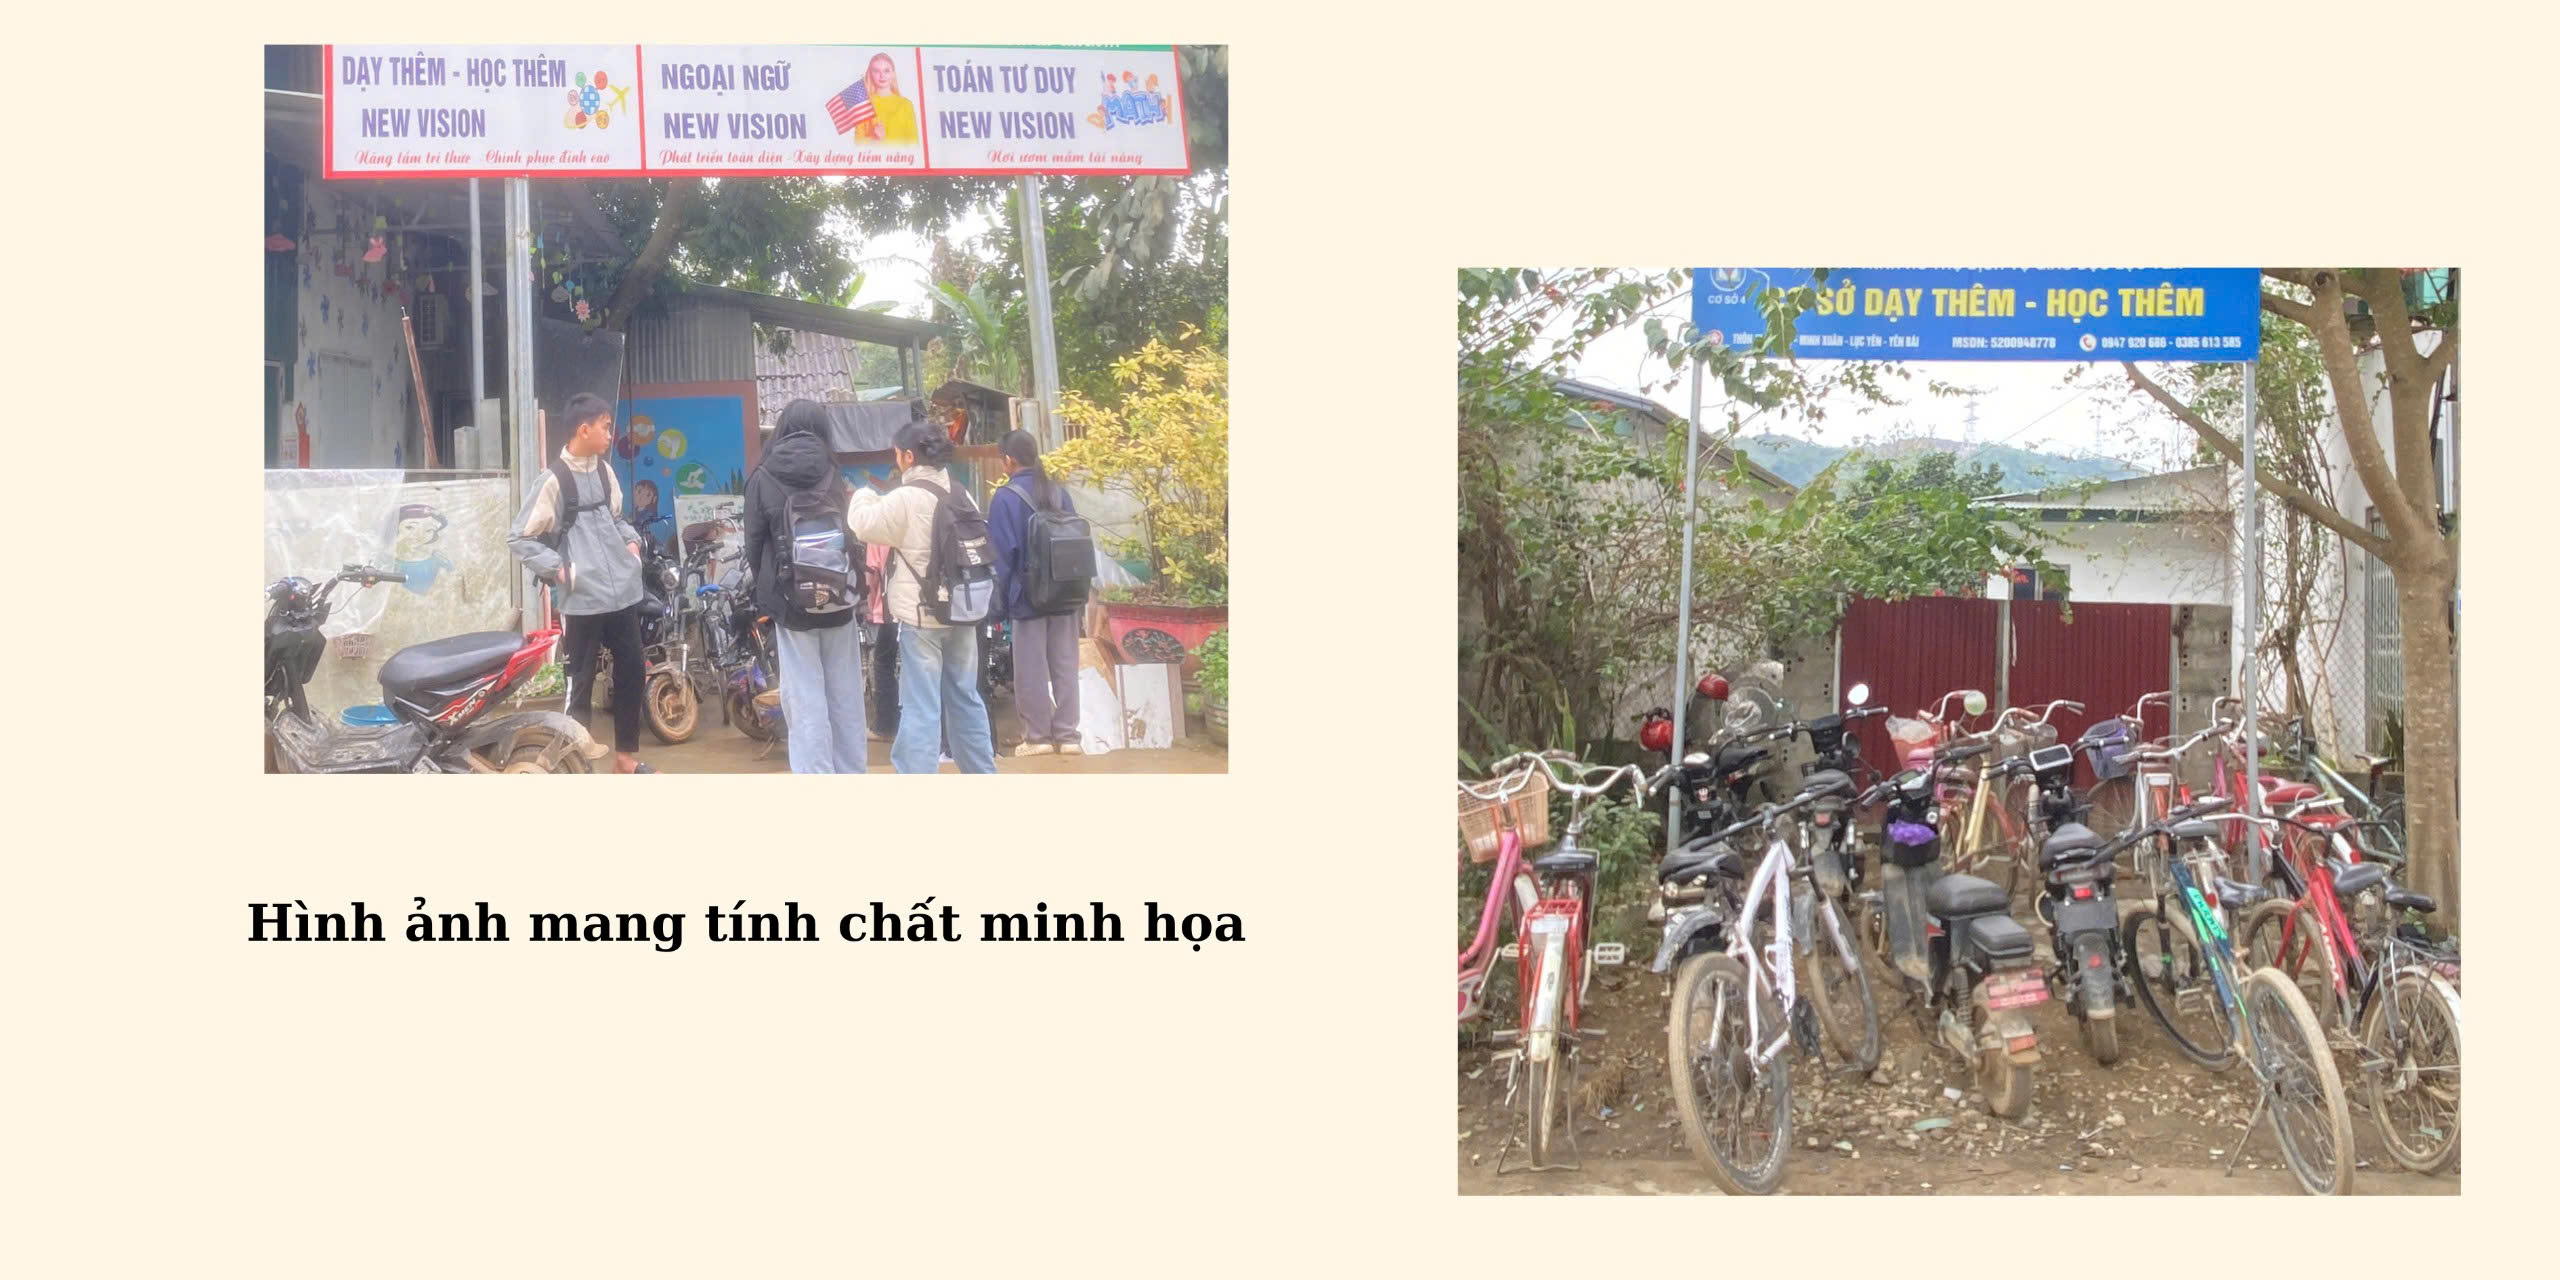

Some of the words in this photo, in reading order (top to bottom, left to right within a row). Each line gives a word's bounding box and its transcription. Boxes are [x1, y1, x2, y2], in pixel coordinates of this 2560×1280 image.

[343, 56, 382, 92] DẠY
[389, 51, 445, 86] THÊM
[467, 58, 506, 93] HỌC
[513, 54, 566, 87] THÊM
[661, 64, 735, 96] NGOẠI
[743, 60, 791, 90] NGỮ
[933, 60, 994, 93] TOÁN
[1000, 64, 1029, 93] TƯ
[1034, 67, 1075, 93] DUY
[362, 108, 411, 137] NEW
[417, 109, 485, 137] VISION
[939, 111, 991, 138] NEW
[1000, 112, 1075, 139] VISION
[1102, 90, 1165, 130] MATH
[664, 113, 719, 139] NEW
[727, 114, 806, 139] VISION
[1708, 294, 1723, 304] CƠ
[1740, 296, 1746, 304] 4
[1817, 278, 1856, 315] SỞ
[1865, 288, 1922, 322] DẠY
[1932, 283, 2014, 316] THÊM
[2047, 289, 2107, 323] HỌC
[2119, 282, 2204, 316] THÊM
[2102, 337, 2125, 348] 0947
[2128, 337, 2146, 348] 920
[2202, 337, 2219, 349] 613
